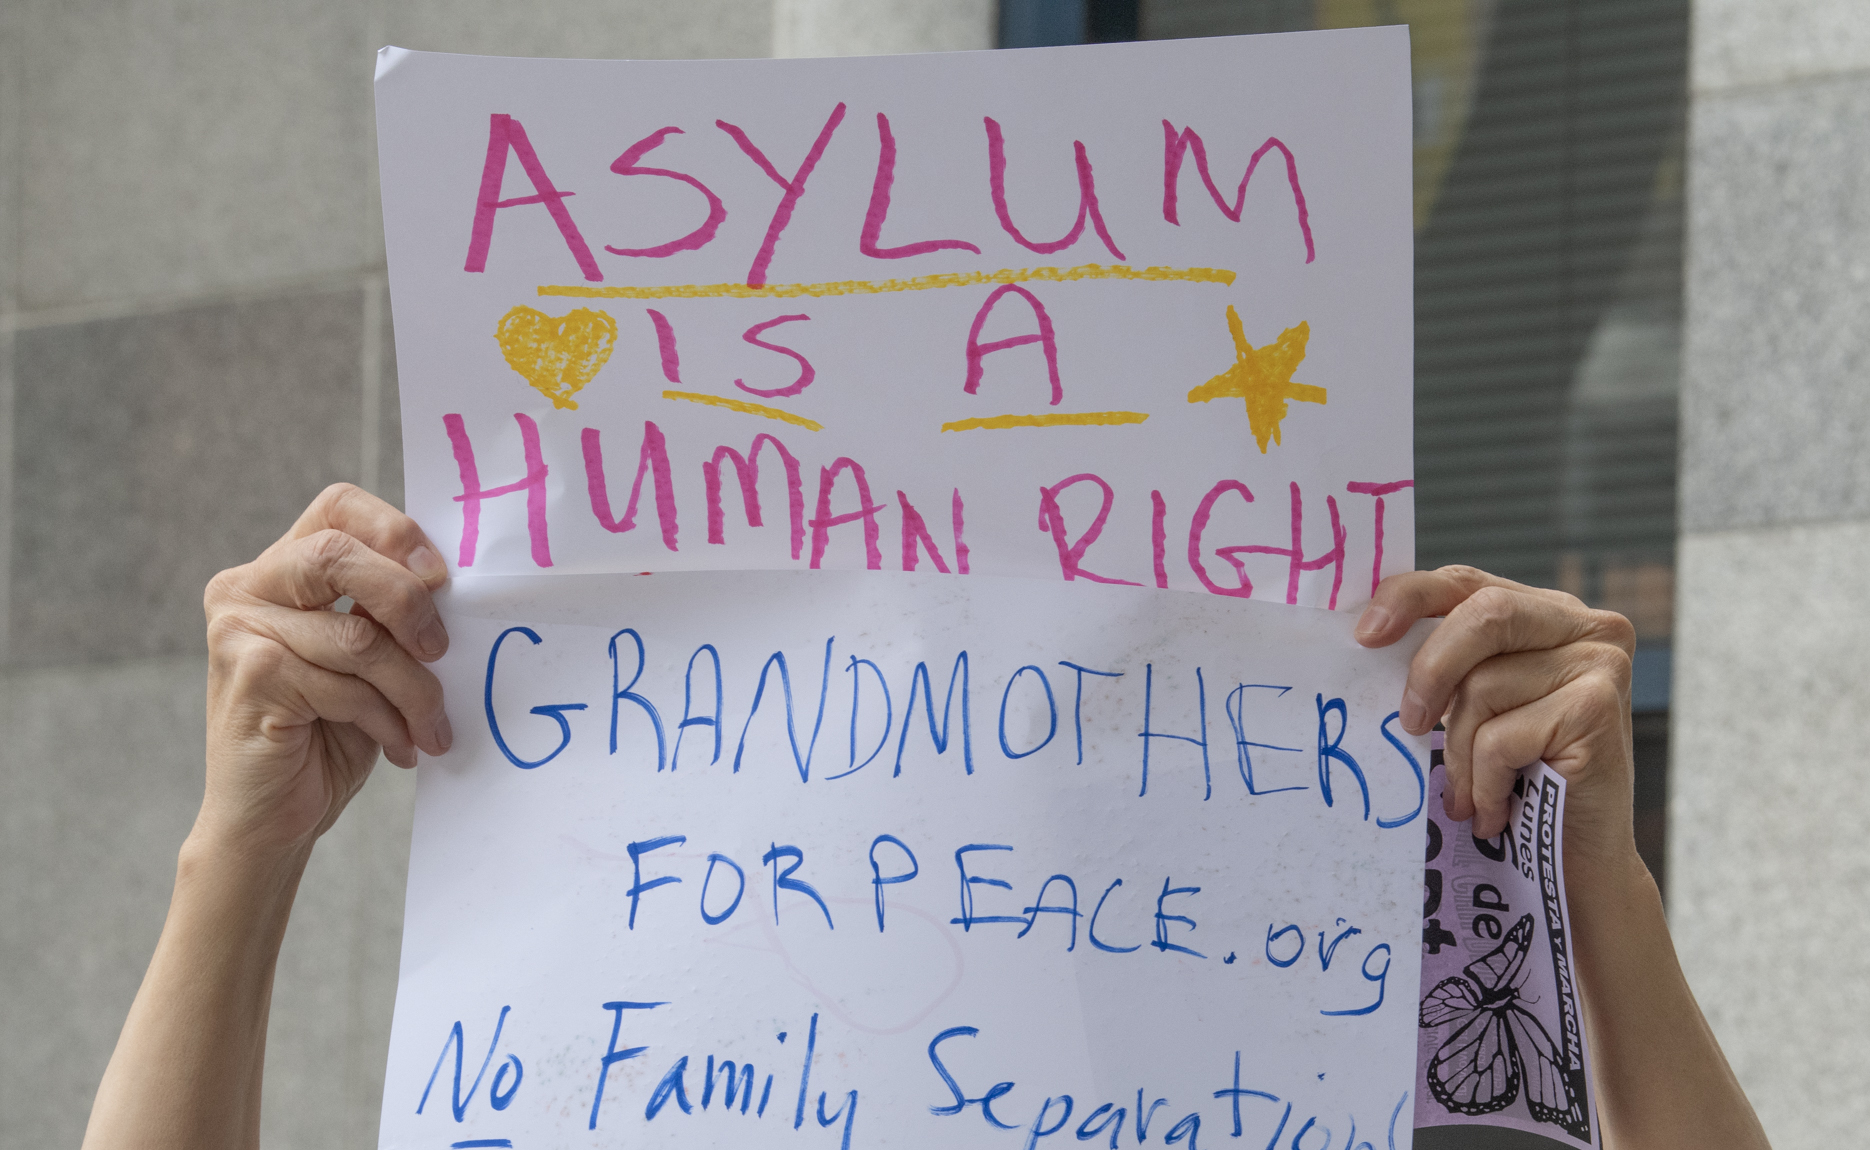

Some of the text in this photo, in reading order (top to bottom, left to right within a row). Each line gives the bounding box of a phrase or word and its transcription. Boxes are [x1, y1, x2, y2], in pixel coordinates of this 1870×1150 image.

[463, 101, 1315, 288] ASYLUM
[646, 284, 1063, 406] IS A
[442, 412, 1414, 611] HUMAN RIGHT
[484, 626, 1426, 828] GRANDMOTHERS
[1520, 778, 1540, 882] Lunes
[1472, 883, 1510, 940] de
[1542, 783, 1564, 930] PROTESTA
[1557, 953, 1582, 1072] MARCHA
[415, 1005, 524, 1122] No
